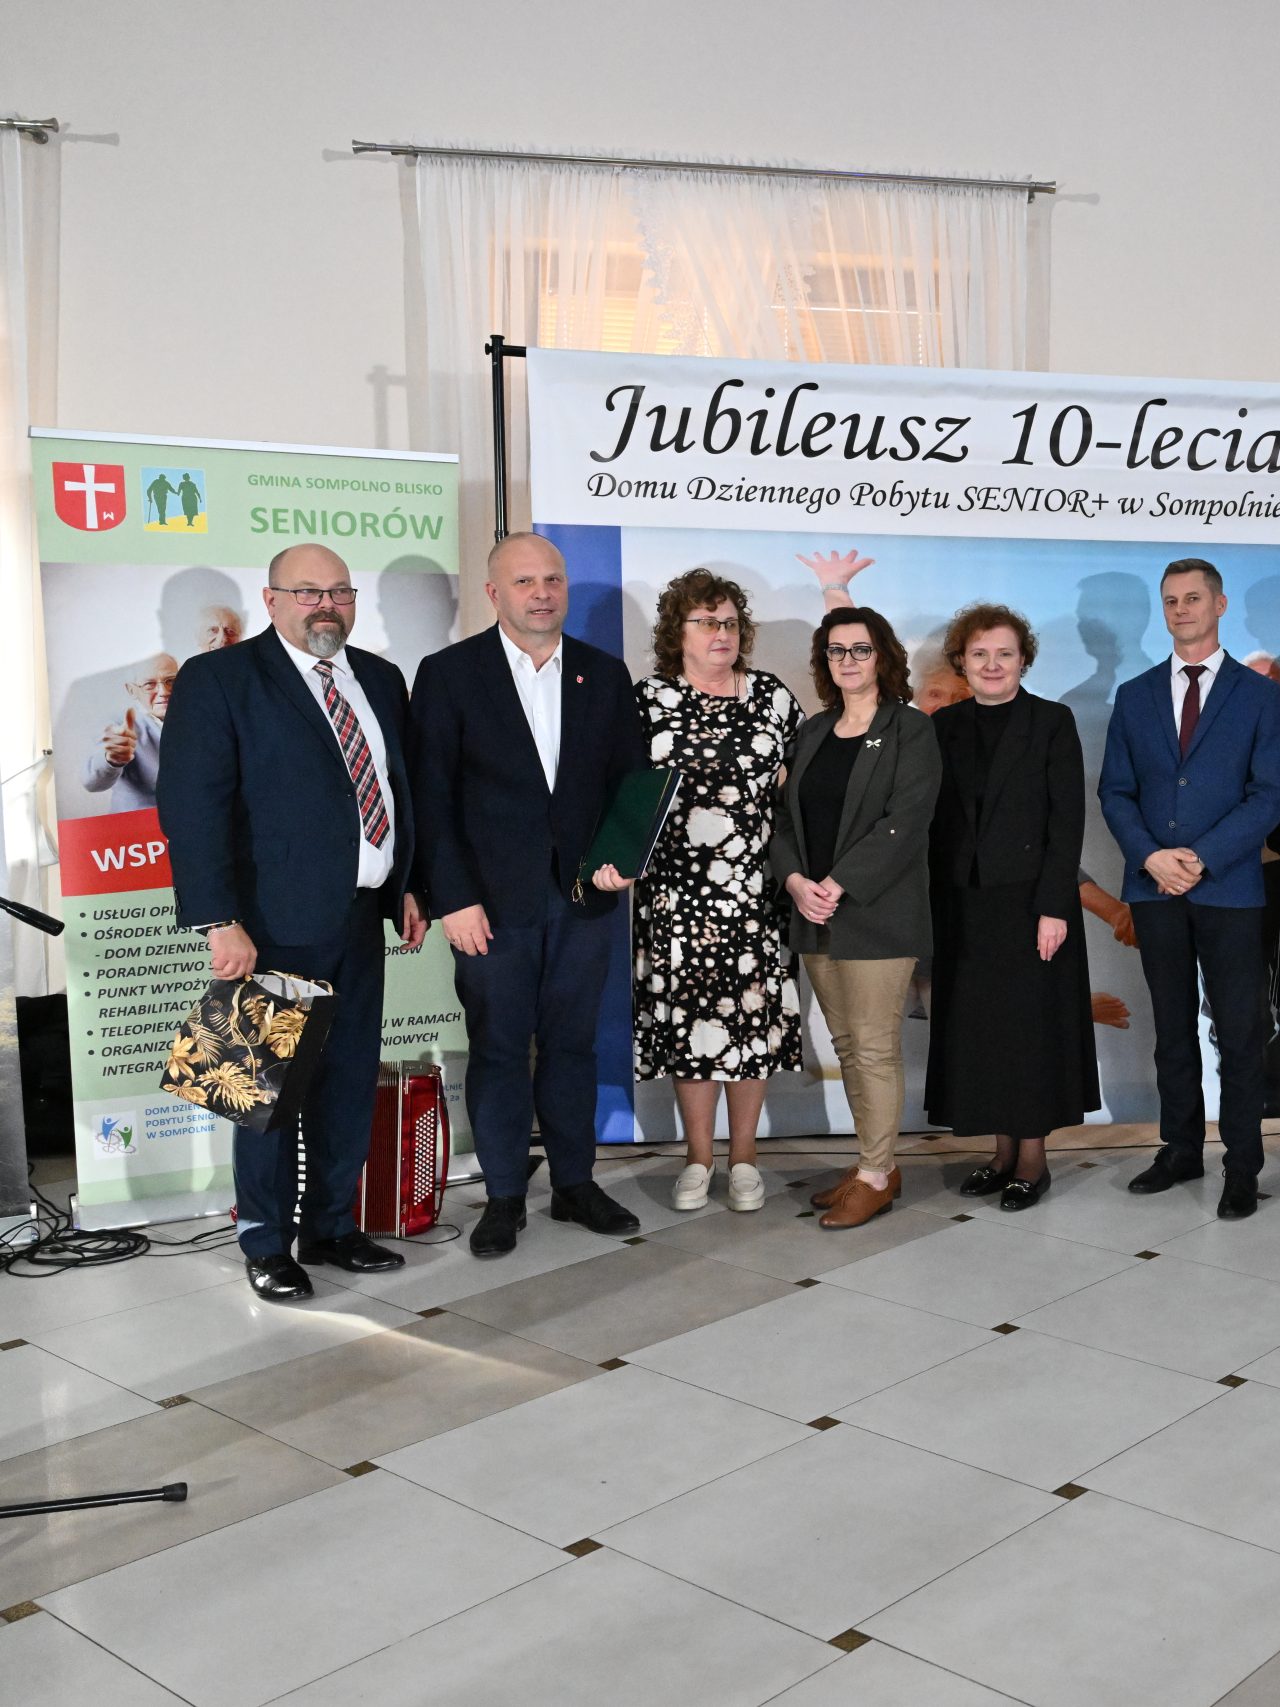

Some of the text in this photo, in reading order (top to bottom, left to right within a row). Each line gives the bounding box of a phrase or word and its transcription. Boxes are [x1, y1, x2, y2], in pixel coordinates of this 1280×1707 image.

[589, 378, 972, 463] Jubileusz
[247, 474, 443, 496] GMINA SOMPOLNO BLISKO
[587, 472, 678, 499] Domu
[686, 476, 841, 514] Dziennego
[849, 480, 950, 516] Pobytu
[956, 485, 1110, 518] SENIOR+
[1117, 496, 1144, 515] w
[250, 506, 444, 540] SENIORÓW
[91, 840, 169, 872] WSP
[93, 905, 177, 921] USŁUGI OPI
[94, 925, 163, 940] OŚRODEK
[104, 946, 141, 960] DOM
[96, 961, 205, 980] PORADNICTWO
[97, 985, 147, 999] PUNKT
[98, 999, 199, 1019] REHABILITACY
[391, 1017, 405, 1028] W
[407, 1011, 461, 1026] RAMACH
[100, 1020, 183, 1038] TELEOPIEKA
[145, 1106, 170, 1116] DOM
[146, 1116, 184, 1128] POBYTU
[147, 1123, 217, 1140] W SOMPOLNIE
